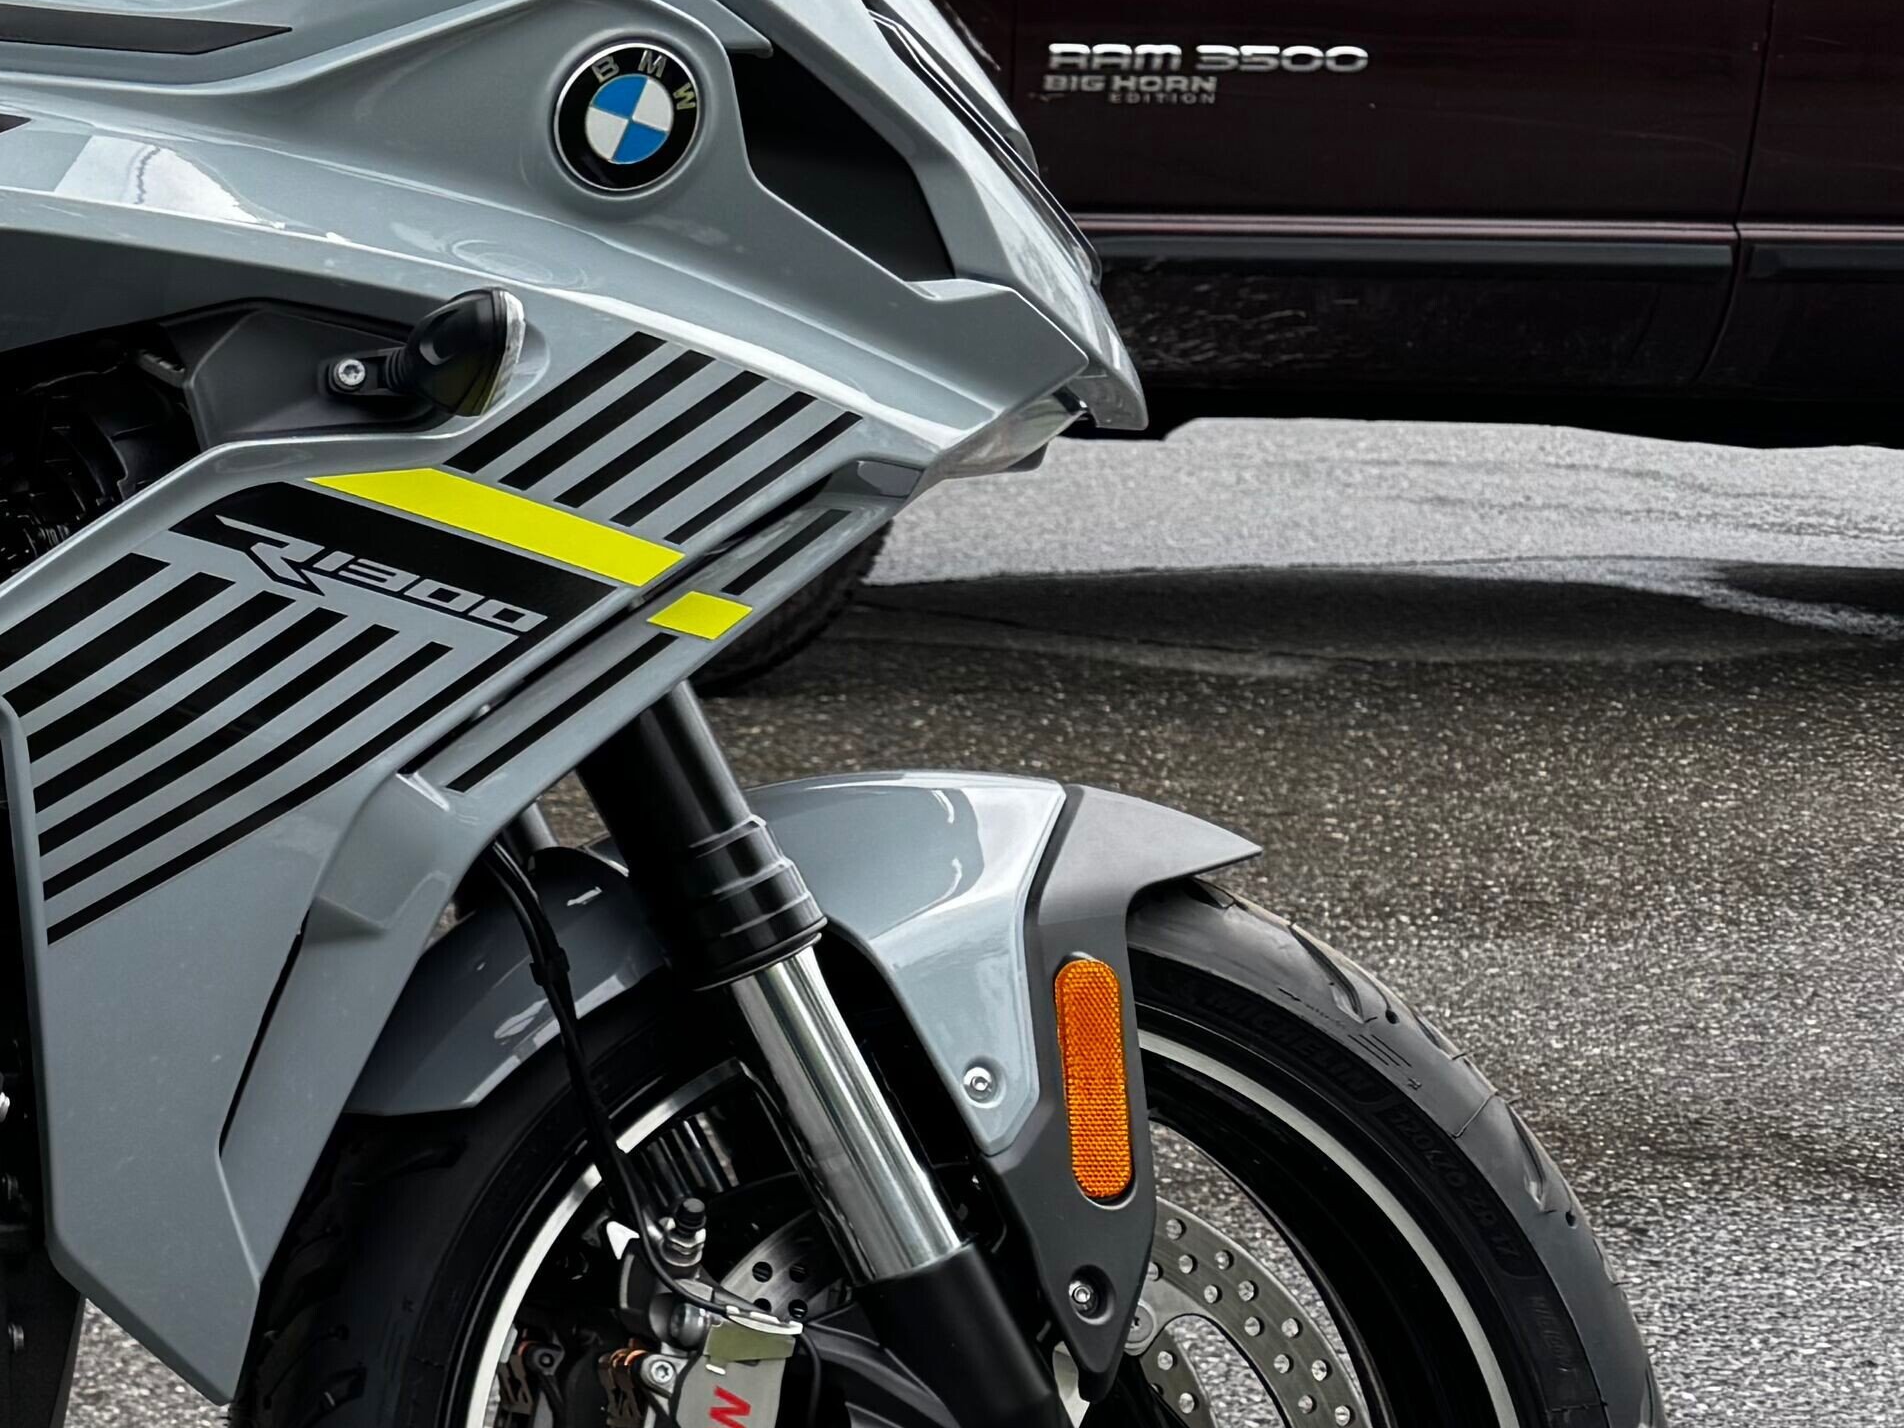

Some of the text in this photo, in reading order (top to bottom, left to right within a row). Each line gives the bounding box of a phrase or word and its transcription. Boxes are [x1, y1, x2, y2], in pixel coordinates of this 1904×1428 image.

[1049, 42, 1369, 72] RAM 3500
[592, 49, 696, 111] BMW
[1043, 75, 1218, 94] BIG HORN
[1109, 92, 1217, 105] EDITION
[215, 515, 549, 633] R1300
